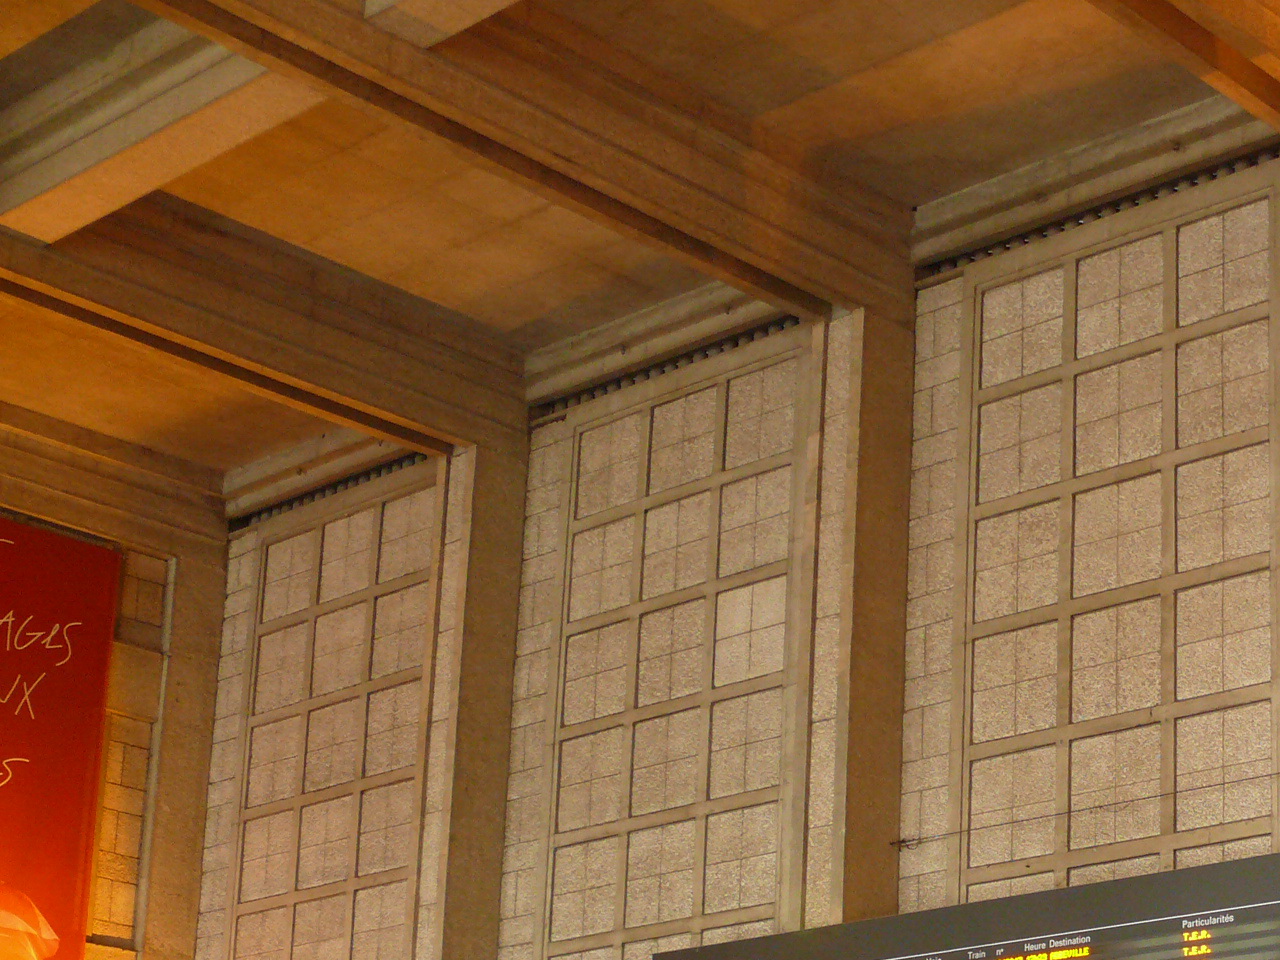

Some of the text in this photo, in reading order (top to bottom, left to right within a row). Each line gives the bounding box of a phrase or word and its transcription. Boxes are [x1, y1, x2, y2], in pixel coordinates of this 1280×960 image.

[1182, 914, 1234, 929] Particularités
[968, 951, 986, 960] Train
[1024, 942, 1046, 952] Heure
[1049, 935, 1091, 948] Destination
